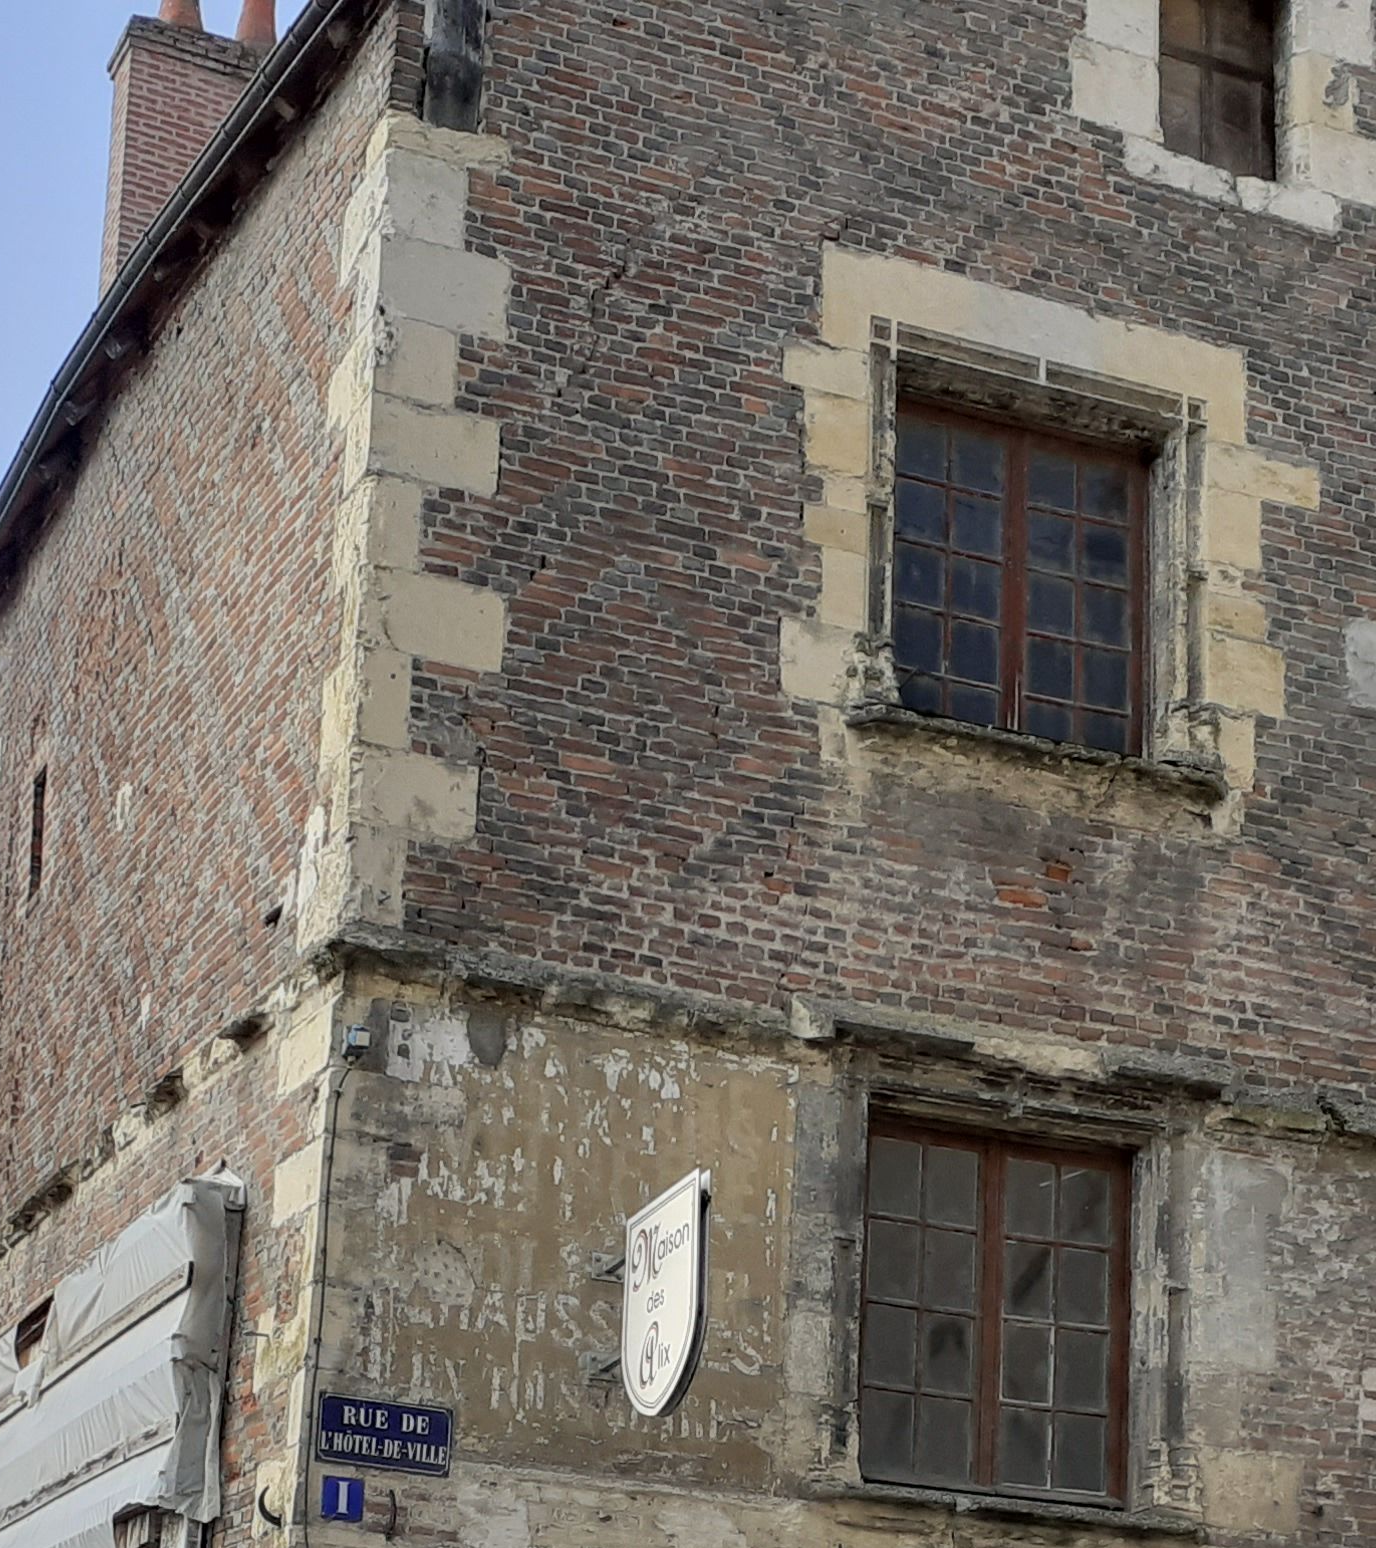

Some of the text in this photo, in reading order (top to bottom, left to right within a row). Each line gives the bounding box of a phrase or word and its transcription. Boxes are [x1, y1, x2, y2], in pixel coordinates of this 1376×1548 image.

[631, 1222, 690, 1292] Maison
[646, 1289, 665, 1314] des
[639, 1321, 671, 1389] Alix
[343, 1405, 430, 1435] RUE DE
[320, 1430, 447, 1466] L'HÔTEL-DE-VILLE
